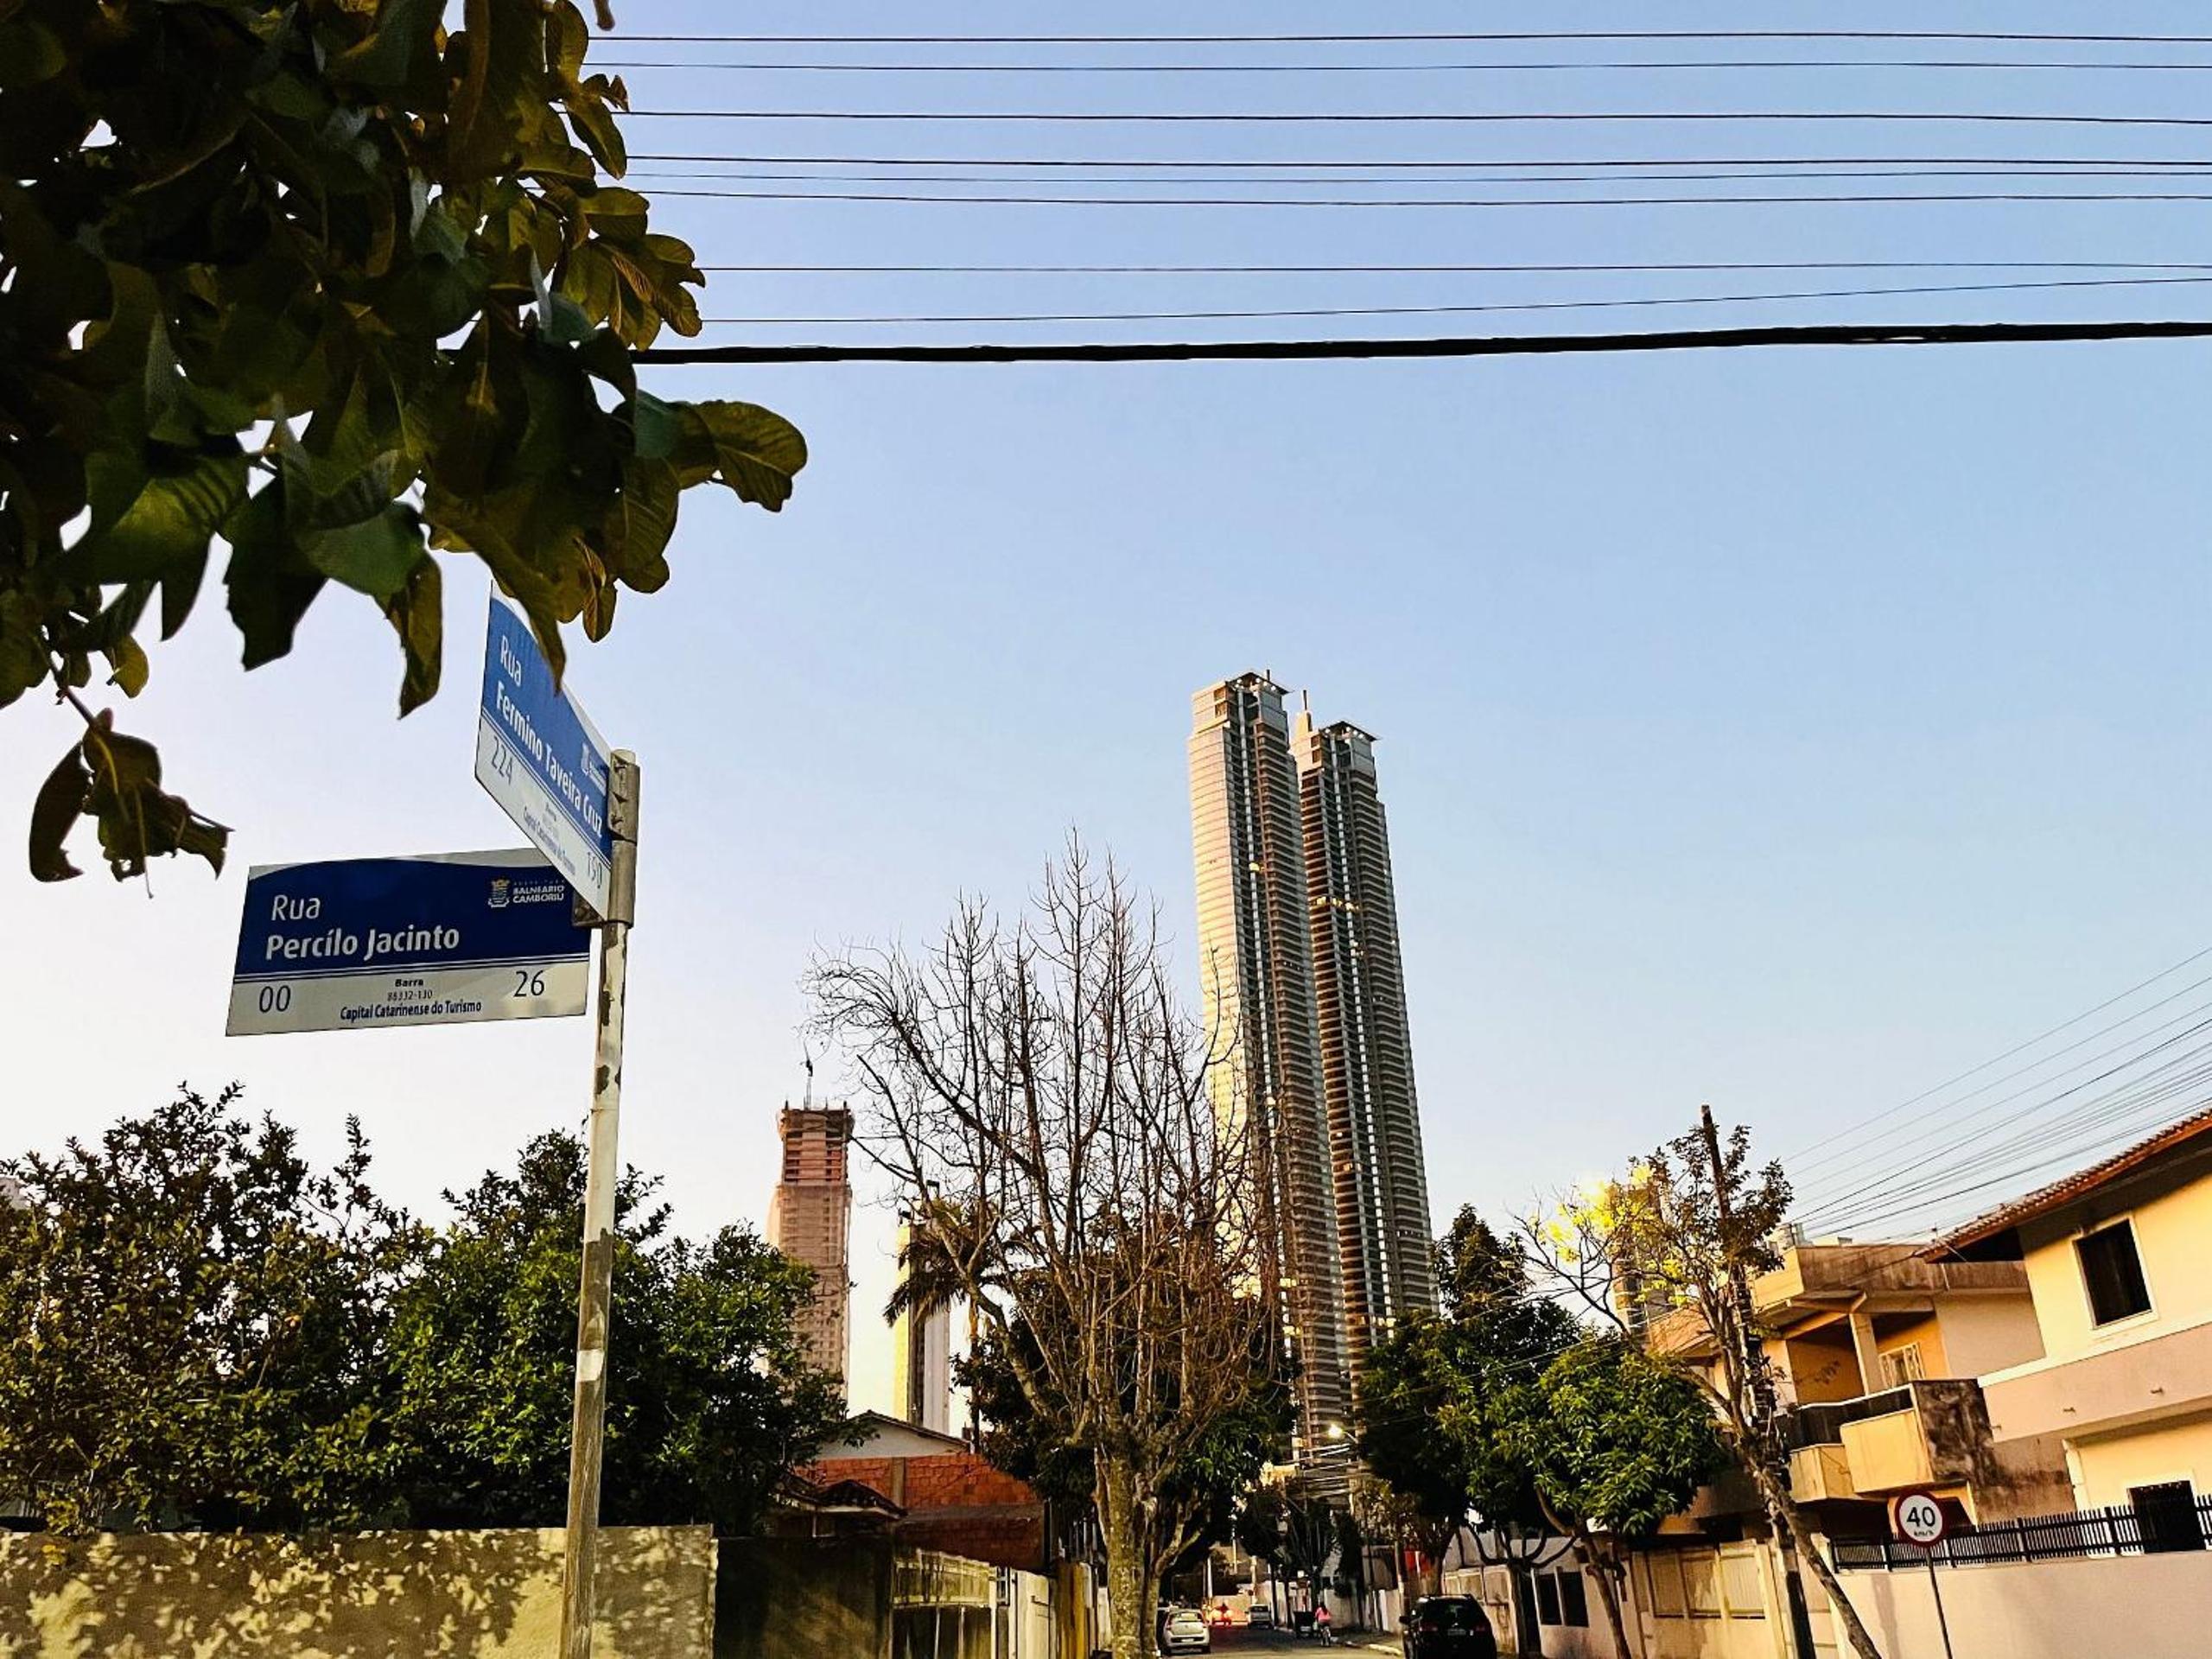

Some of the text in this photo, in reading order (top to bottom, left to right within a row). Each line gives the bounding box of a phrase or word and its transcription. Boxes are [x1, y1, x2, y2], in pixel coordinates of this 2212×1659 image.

[500, 635, 522, 687] Rua
[492, 735, 512, 785] 224
[496, 680, 543, 760] Fermino
[545, 741, 582, 812] Taveira
[582, 794, 603, 838] Cruz
[271, 894, 321, 921] Rua
[265, 924, 460, 961] Percílo Jacinto
[395, 978, 423, 987] Barra
[513, 969, 545, 997] 26
[259, 985, 291, 1014] 00
[340, 999, 482, 1023] Capital Catarinense do Turismo
[1906, 1506, 1936, 1527] 40
